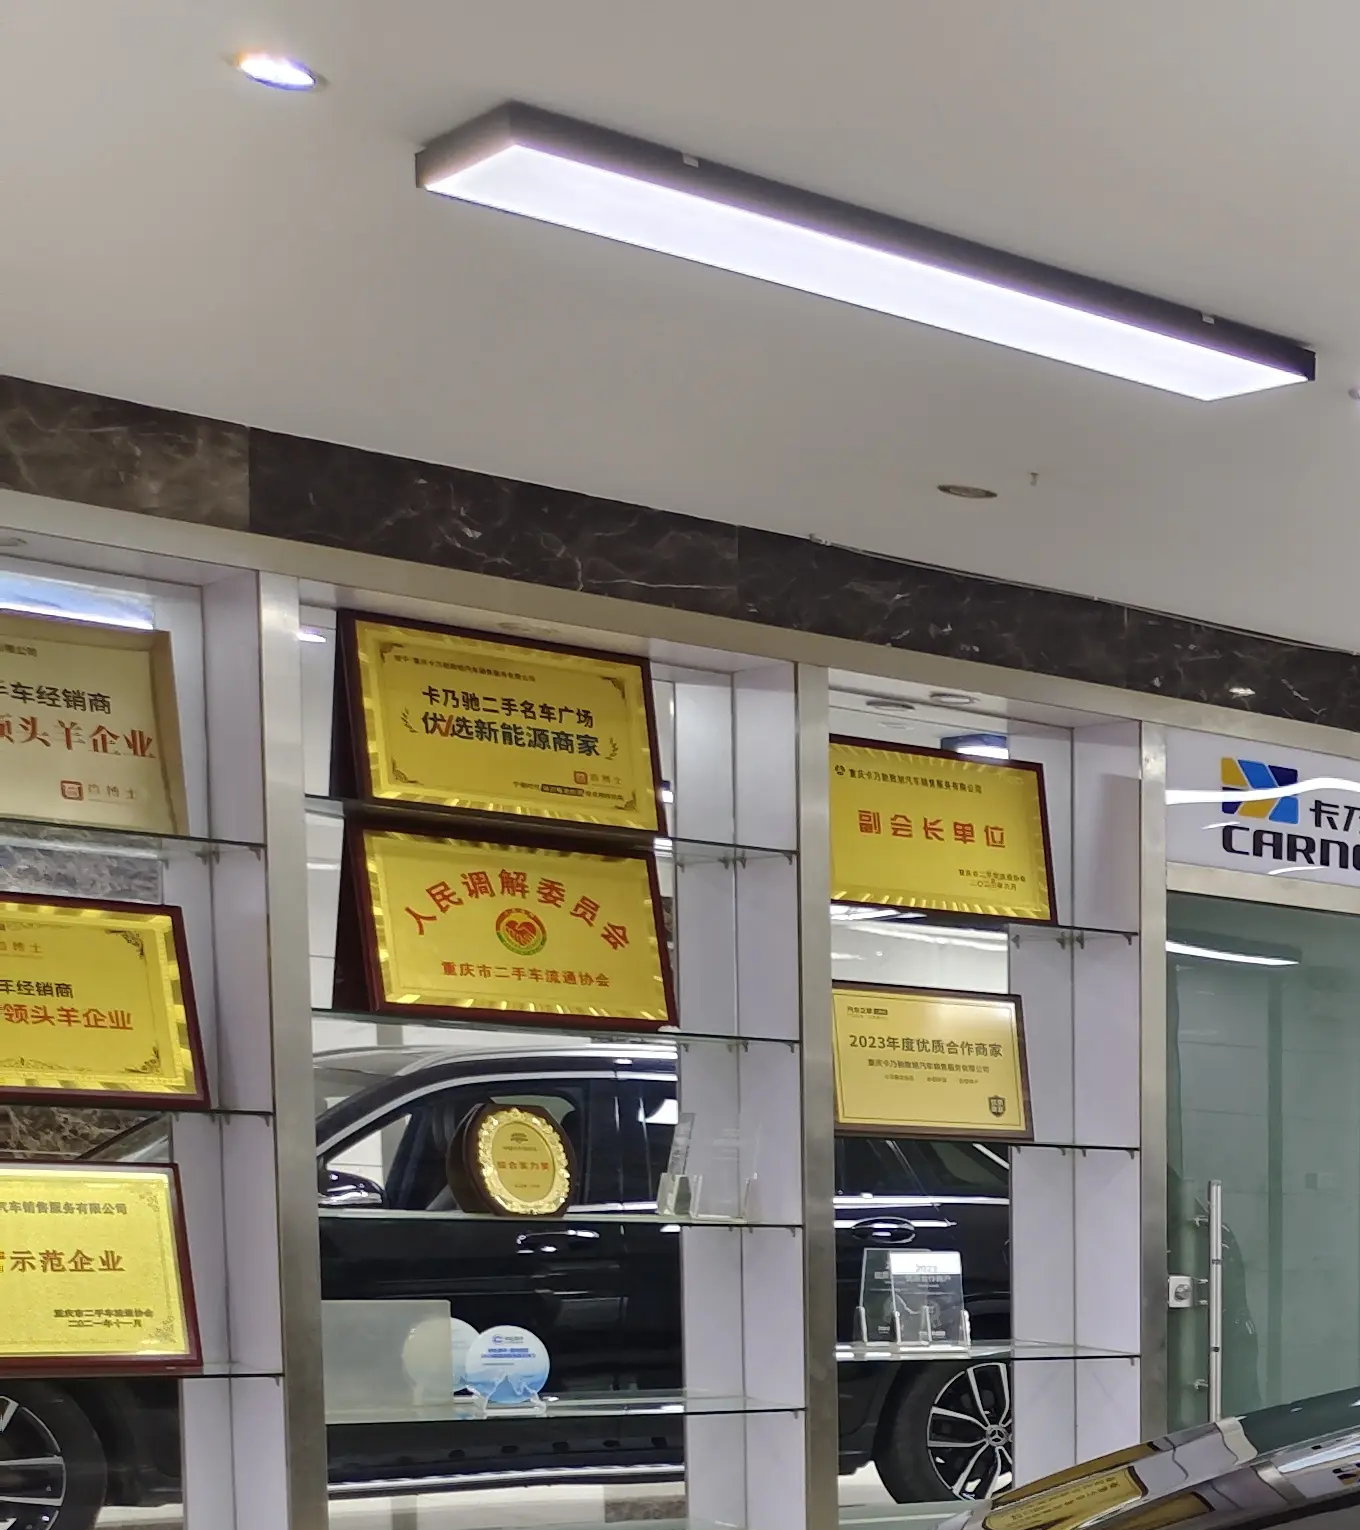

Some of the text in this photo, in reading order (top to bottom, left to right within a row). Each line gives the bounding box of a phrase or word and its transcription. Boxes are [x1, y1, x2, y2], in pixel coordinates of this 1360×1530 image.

[422, 685, 593, 729] 卡乃驰二手名车广场
[421, 711, 601, 757] 优选新能源商家
[857, 809, 1006, 849] 副会长单位
[404, 868, 631, 951] 人民调解委员会
[441, 960, 611, 988] 重庆市二手车流通协会
[0, 1002, 134, 1031] 领头羊企业
[849, 1034, 1004, 1058] 2023年度优质合作商家
